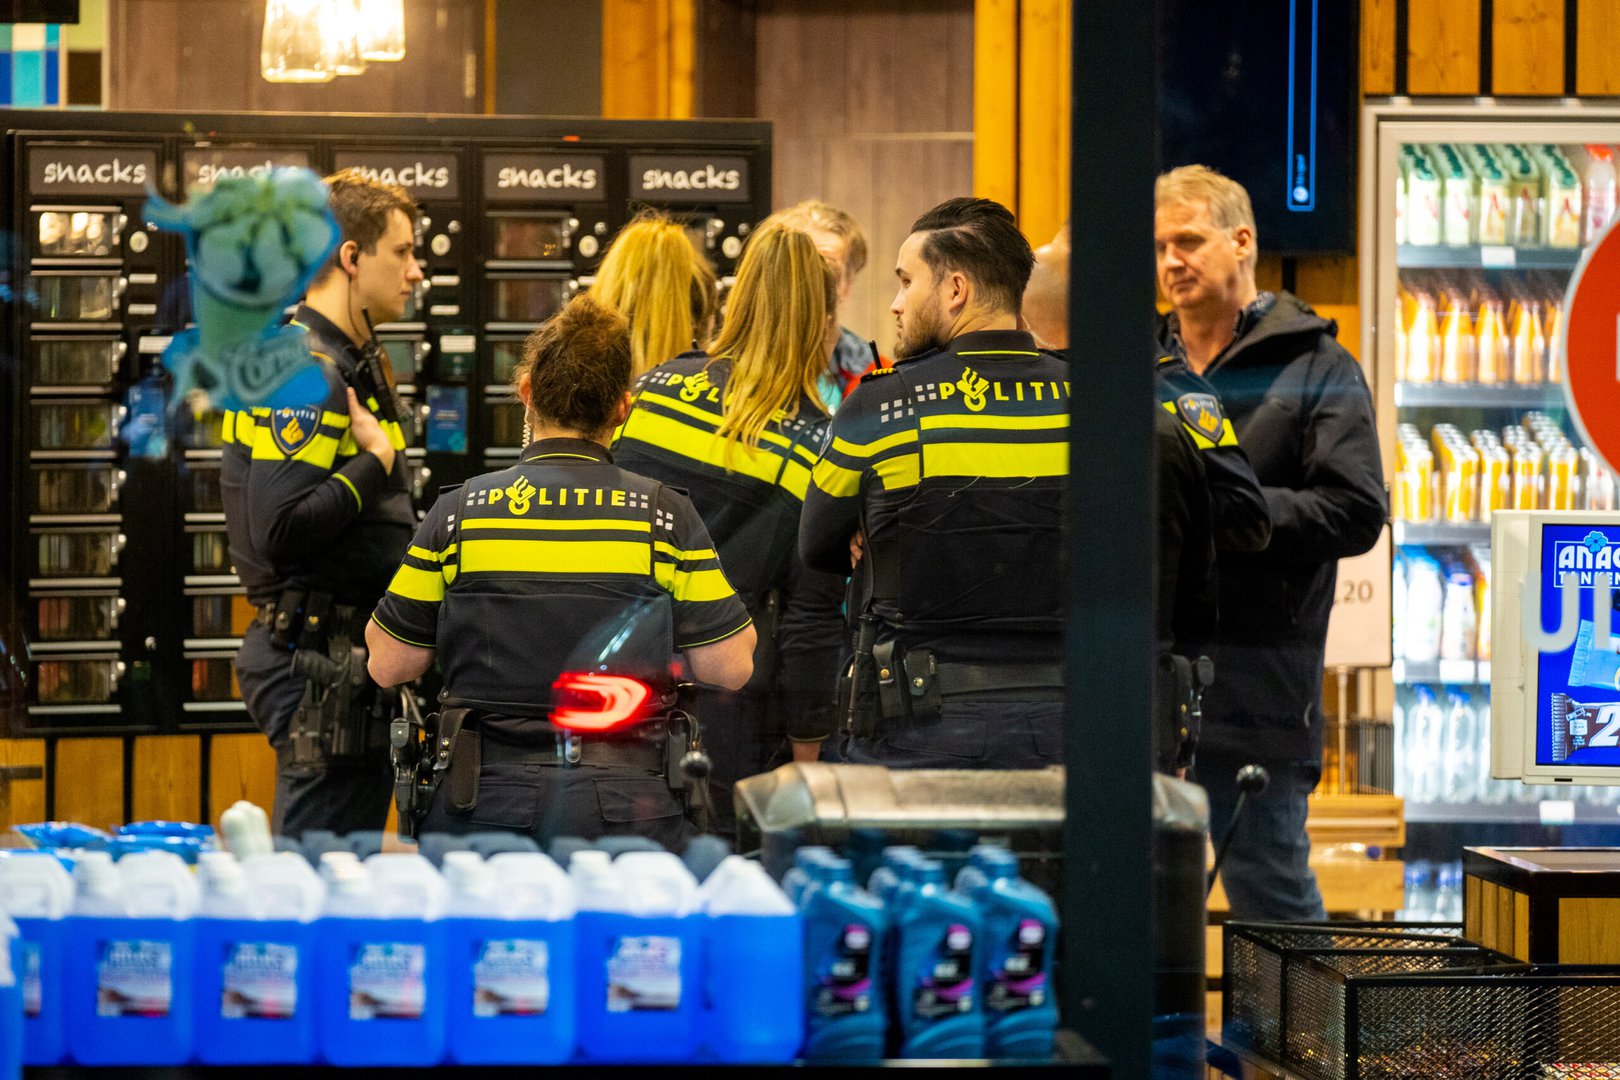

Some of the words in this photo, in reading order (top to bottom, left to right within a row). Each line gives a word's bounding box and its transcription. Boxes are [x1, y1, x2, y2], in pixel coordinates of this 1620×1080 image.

[44, 159, 147, 184] snacks
[498, 163, 597, 189] snacks
[642, 165, 740, 190] snacks
[488, 476, 626, 515] POLITIE
